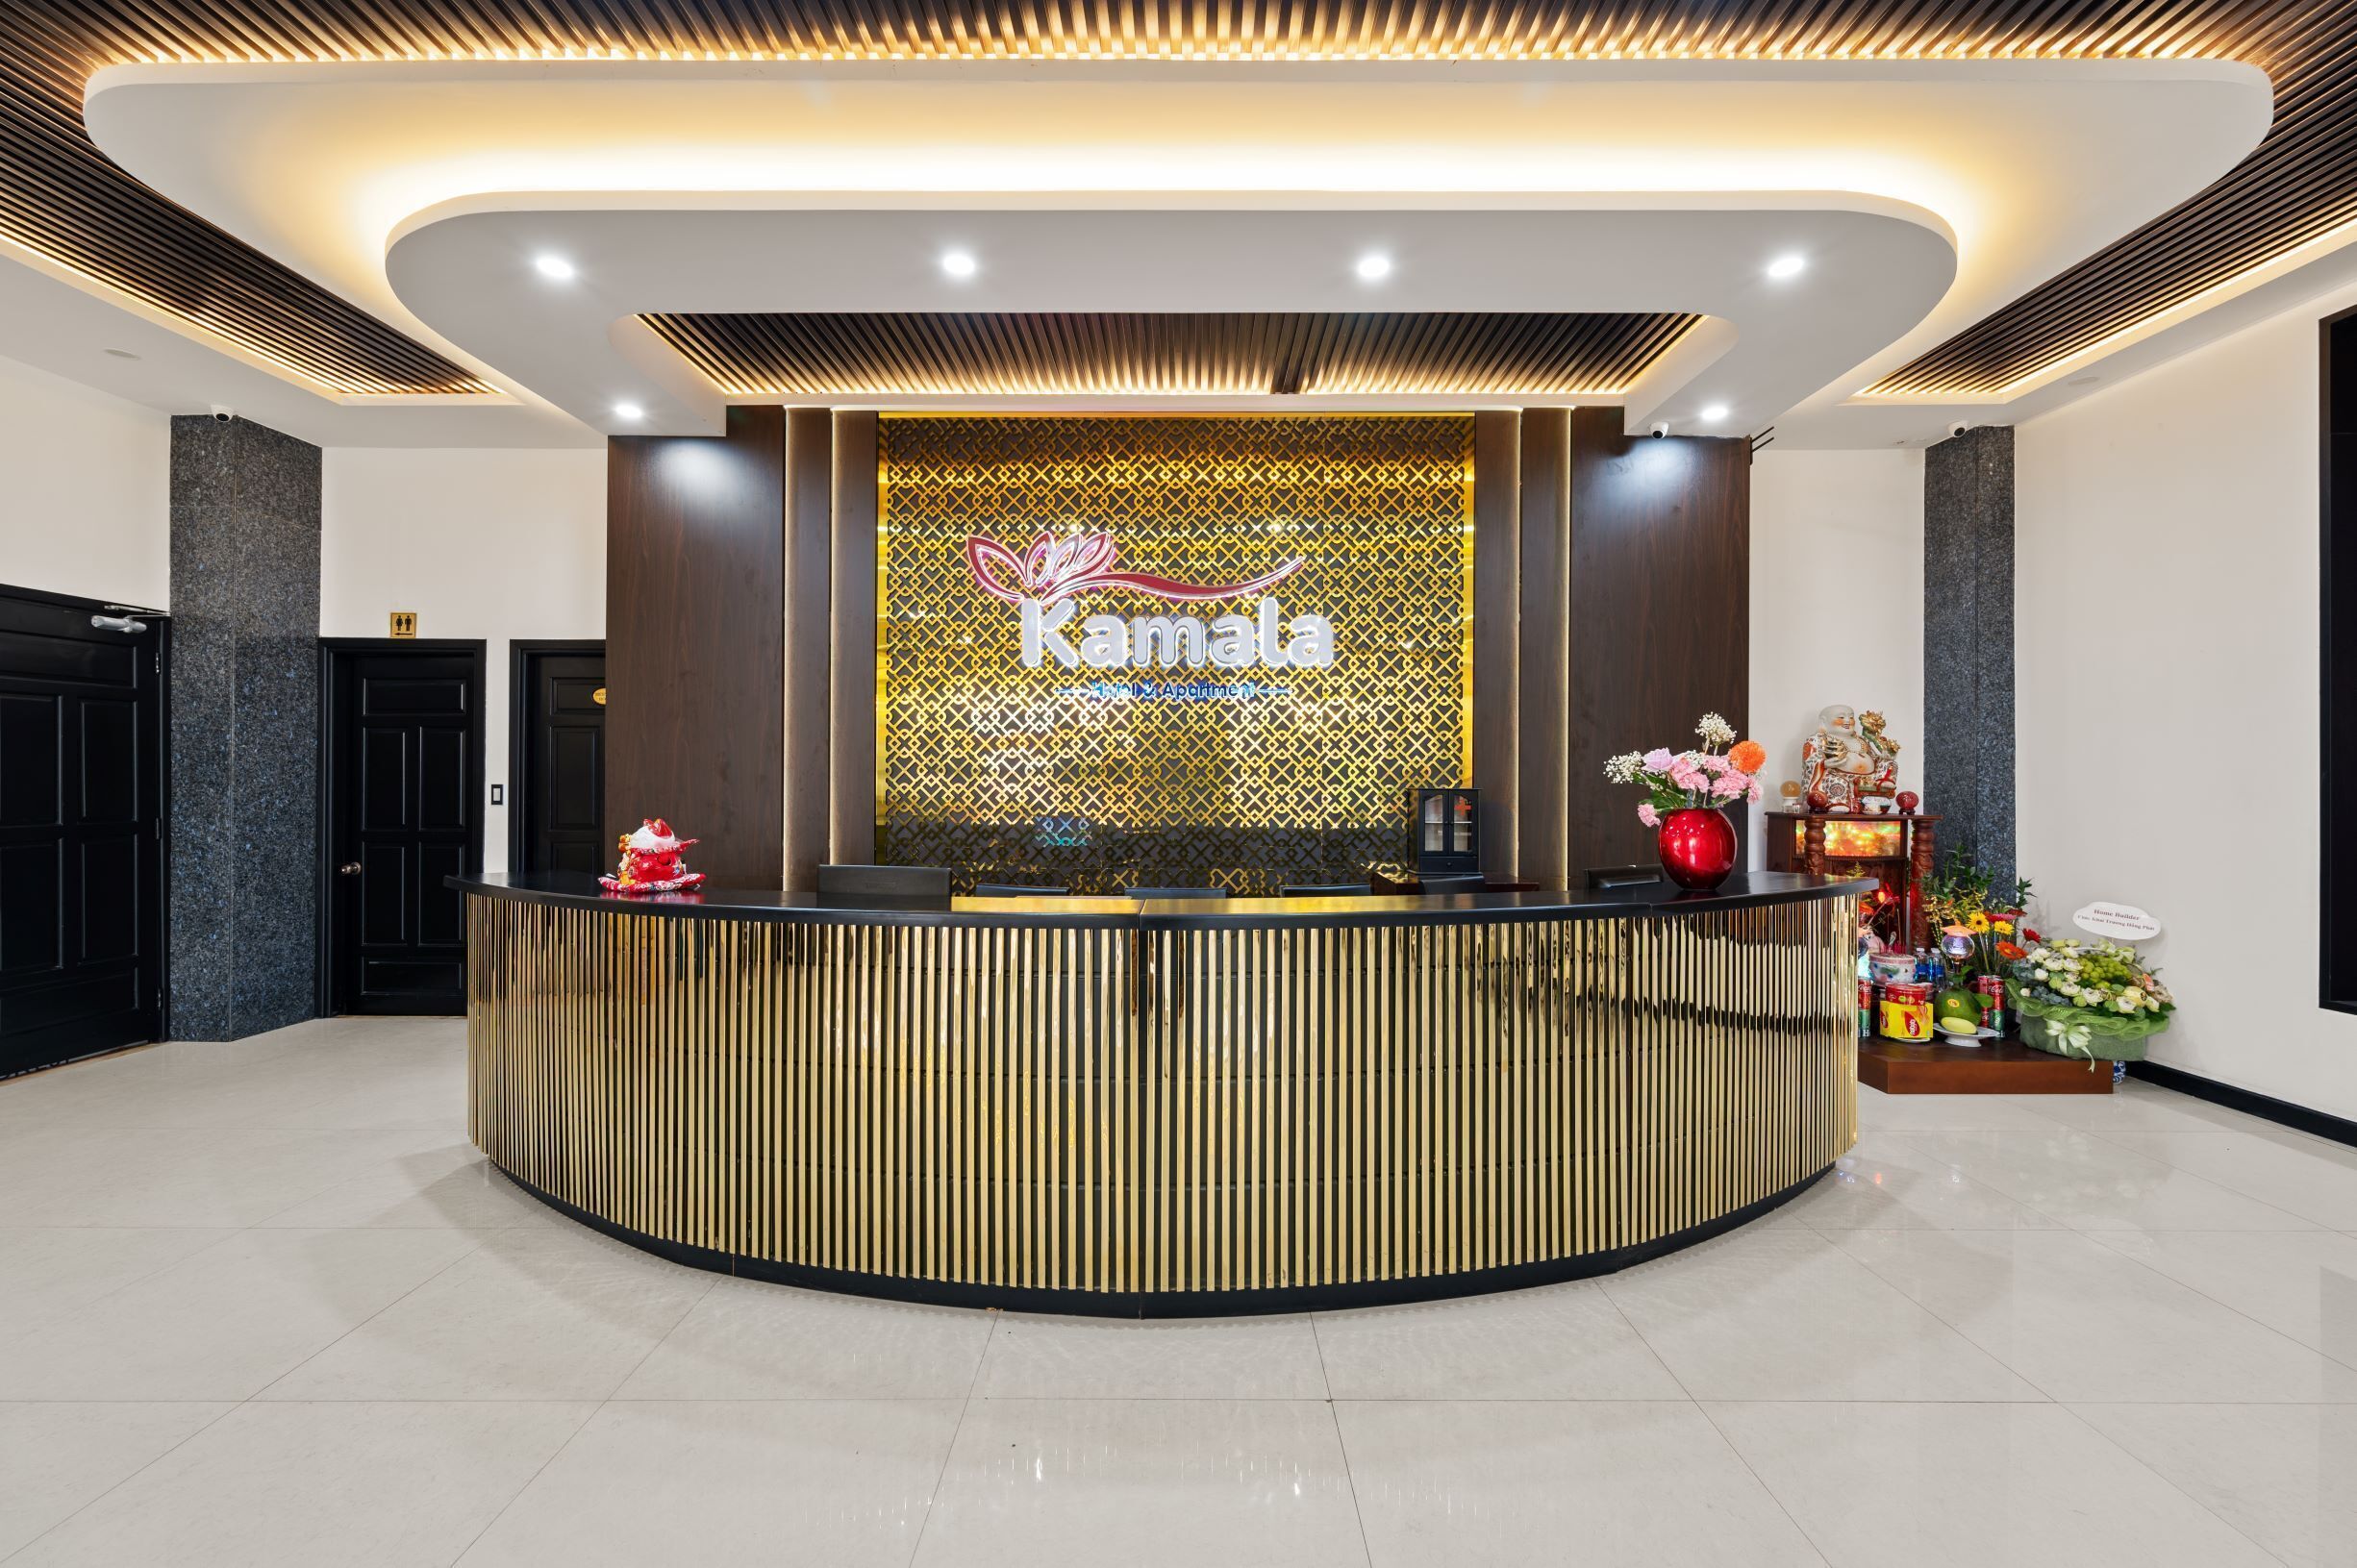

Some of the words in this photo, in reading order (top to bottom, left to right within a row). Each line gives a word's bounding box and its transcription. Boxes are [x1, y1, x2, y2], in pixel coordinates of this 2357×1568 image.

[1021, 597, 1334, 667] Kamala
[1091, 682, 1136, 698] Hotel
[1162, 682, 1255, 701] Apartment
